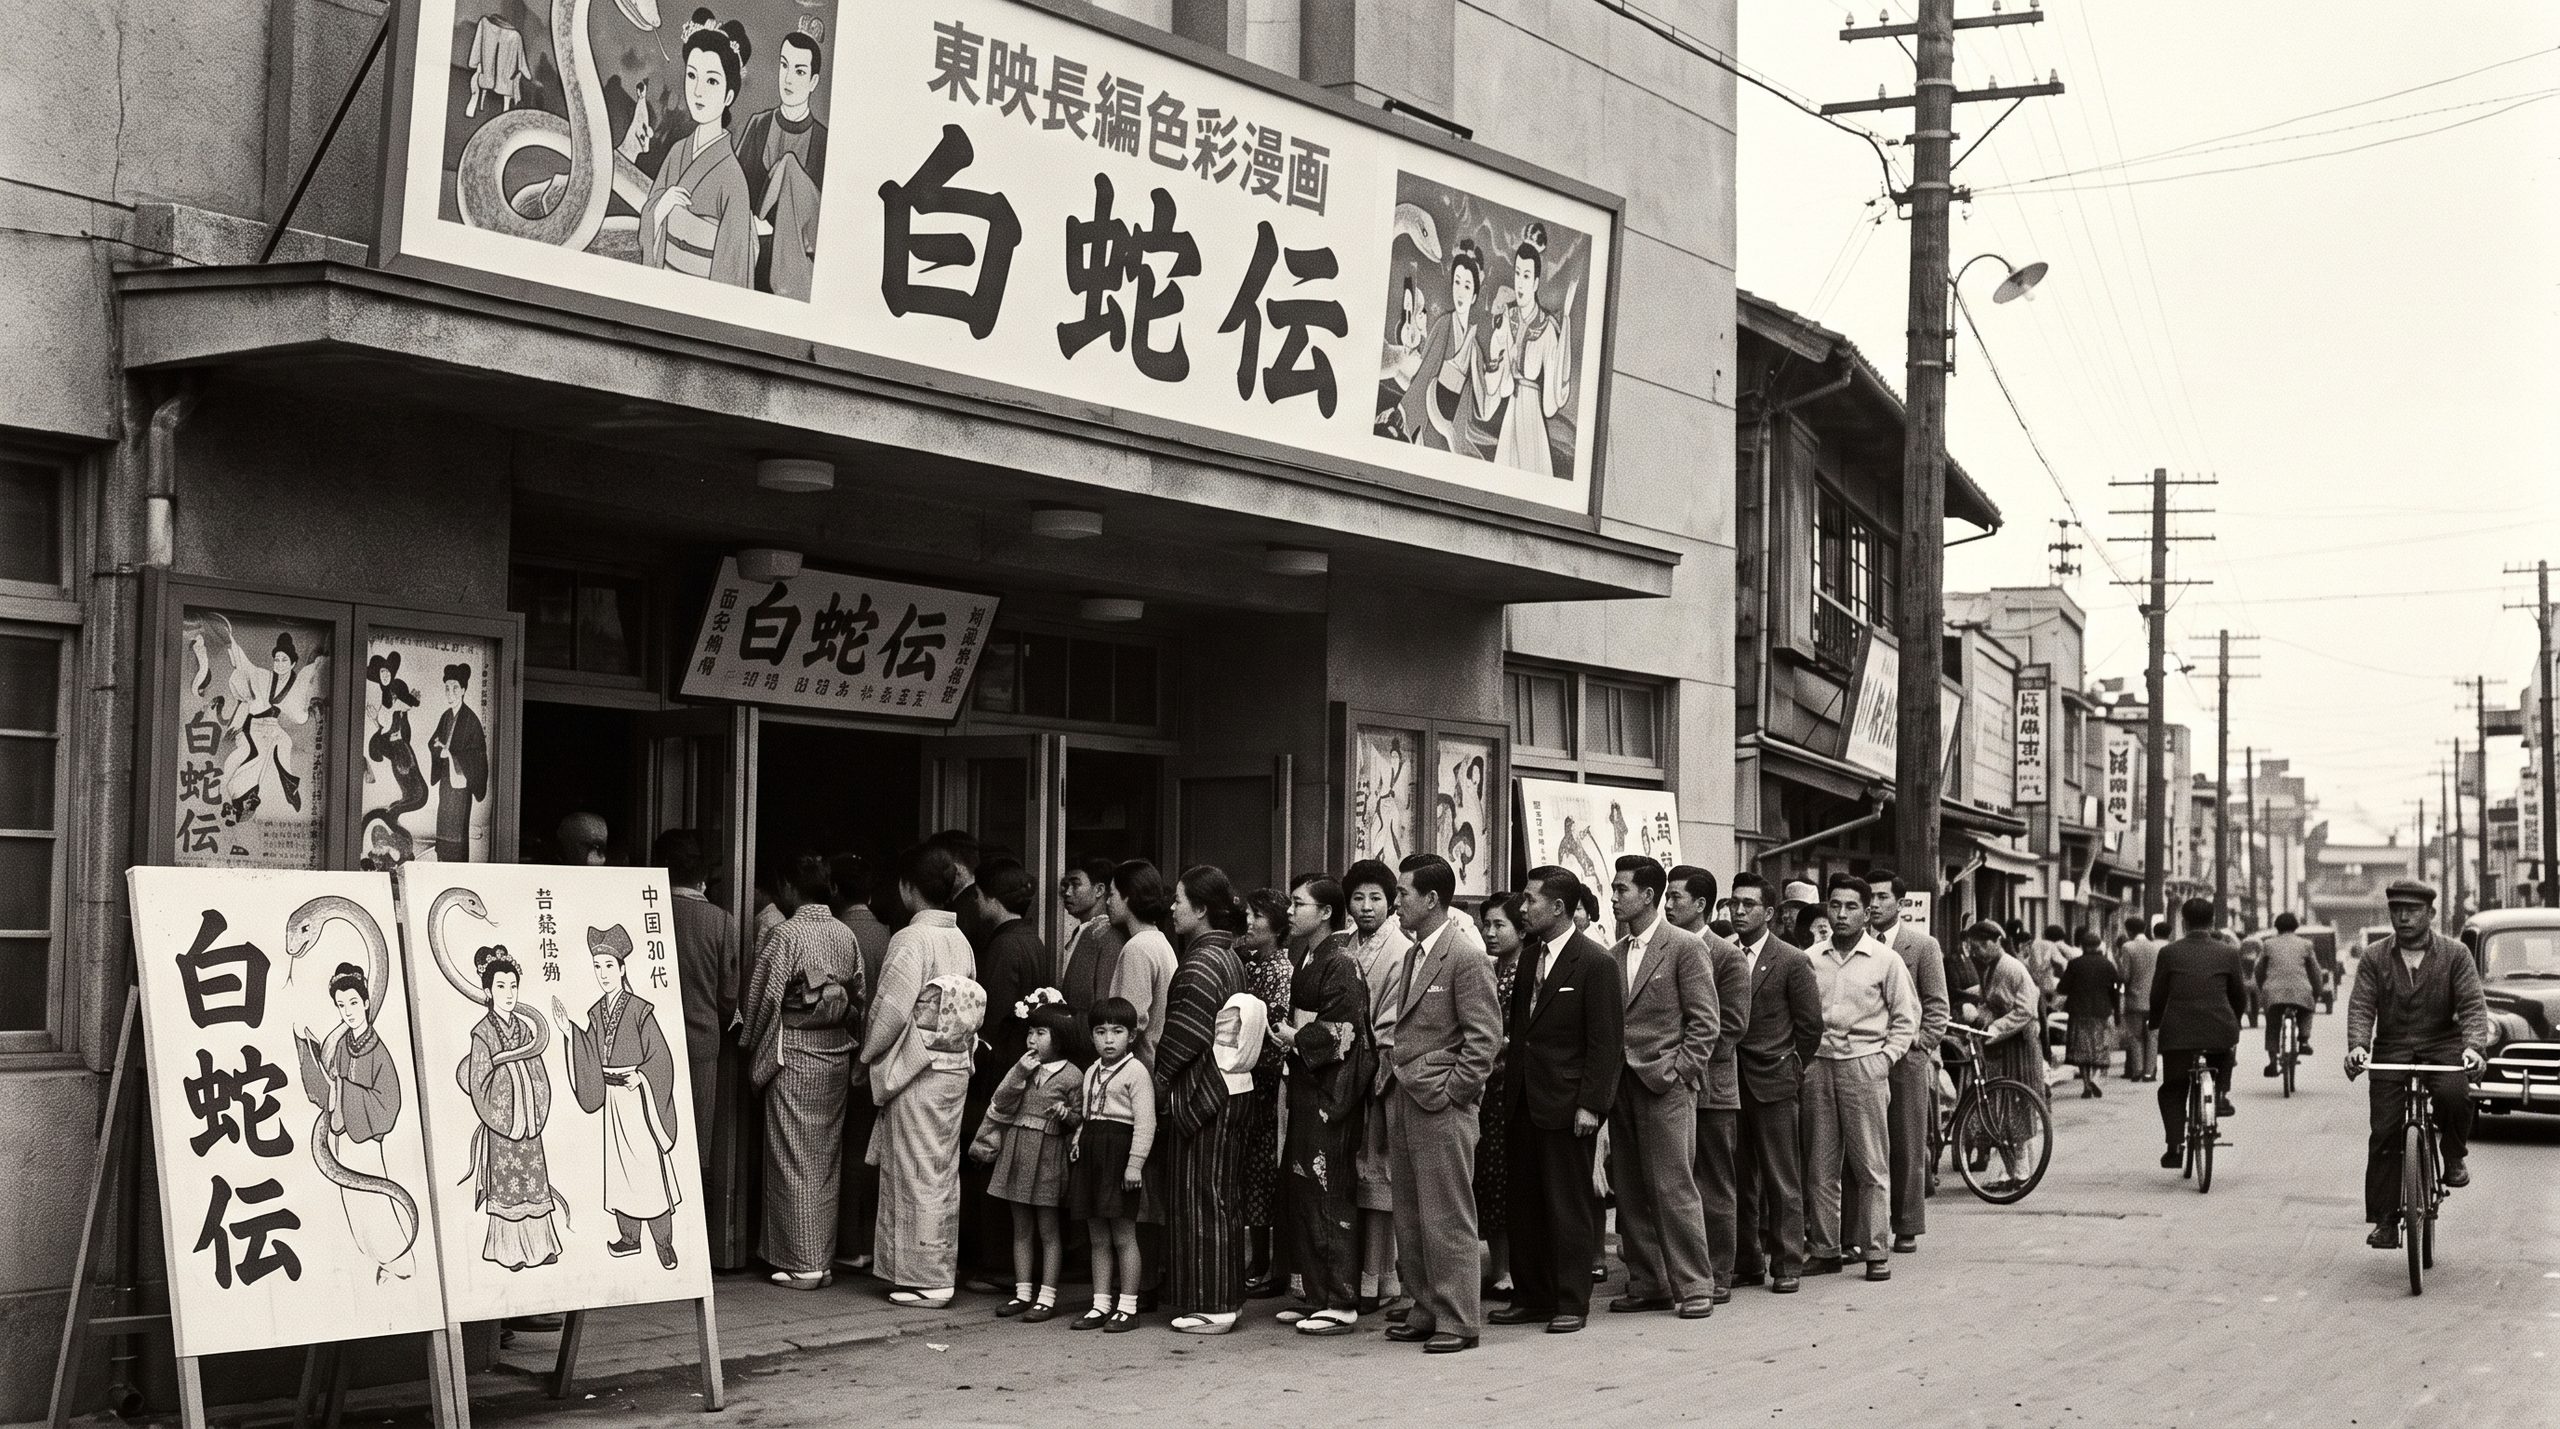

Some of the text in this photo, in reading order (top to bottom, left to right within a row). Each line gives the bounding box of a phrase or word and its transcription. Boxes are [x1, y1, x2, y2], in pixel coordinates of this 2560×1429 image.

[927, 20, 1331, 217] 東映長編色彩漫画
[877, 123, 1350, 419] 白蛇伝
[738, 581, 947, 682] 白蛇伝
[176, 709, 224, 855] 白蛇伝
[641, 884, 669, 989] 中国30代
[174, 908, 302, 1290] 白蛇伝
